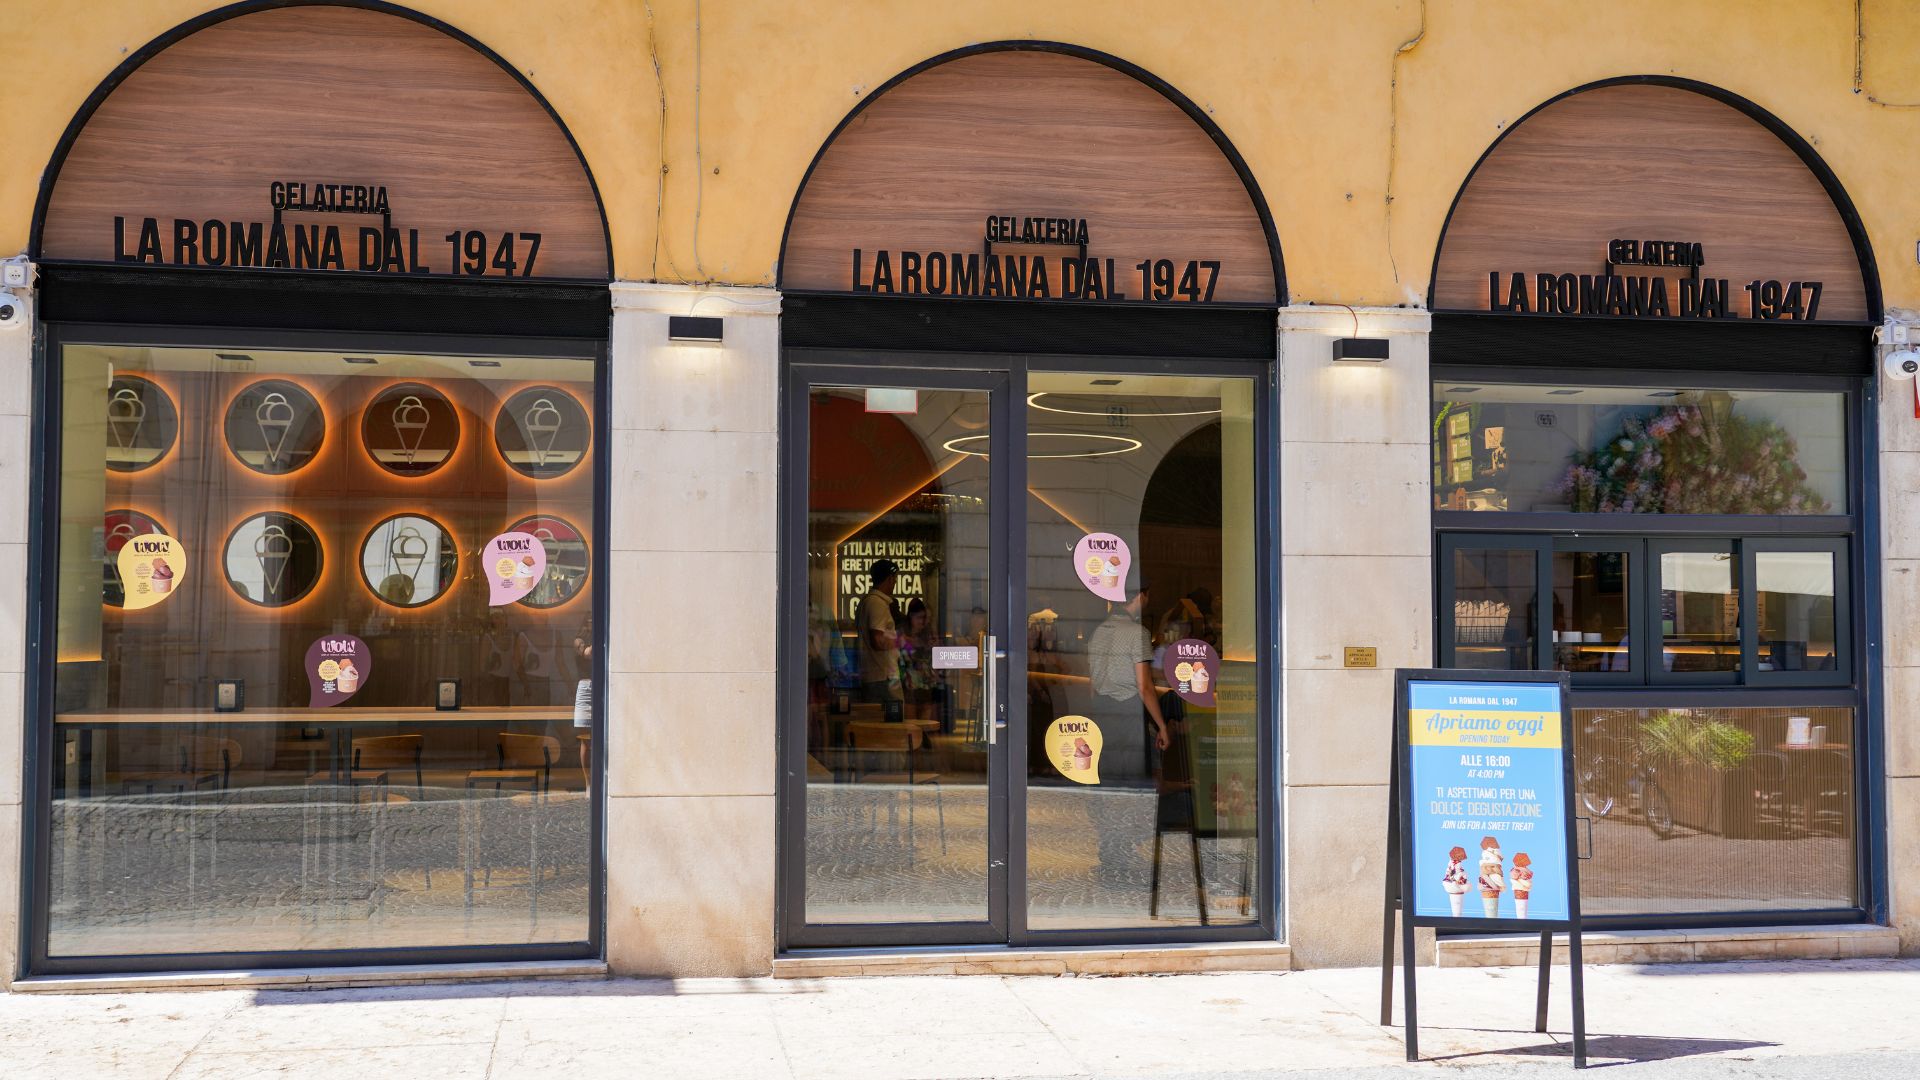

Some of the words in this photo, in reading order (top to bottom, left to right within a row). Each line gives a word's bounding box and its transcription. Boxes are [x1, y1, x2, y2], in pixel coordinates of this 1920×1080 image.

[271, 181, 389, 213] GELATERIA
[986, 215, 1090, 245] GELATERIA
[114, 216, 164, 264] LA
[174, 218, 345, 270] ROMANA
[359, 227, 430, 274] DAL
[445, 230, 542, 277] 1947
[1607, 238, 1705, 267] GELATERIA
[853, 248, 894, 294] LA
[901, 251, 1050, 299] ROMANA
[1061, 257, 1126, 301] DAL
[1136, 259, 1221, 302] 1947
[1488, 271, 1531, 313] LA
[1535, 272, 1670, 317] ROMANA
[1677, 277, 1739, 319] DAL
[1744, 279, 1823, 320] 1947
[842, 558, 862, 572] ERE
[939, 651, 971, 660] SPINGERE
[1449, 696, 1458, 705] LA
[1459, 696, 1486, 705] ROMANA
[1487, 697, 1499, 706] DAL
[1502, 697, 1518, 706] 1947
[1426, 712, 1501, 734] Apriamo
[1506, 715, 1544, 736] oggi
[1459, 734, 1488, 743] OPENING
[1489, 735, 1511, 744] TODAY
[1460, 754, 1482, 767] ALLE
[1485, 755, 1511, 767] 16:00
[1467, 769, 1477, 778] AT
[1477, 769, 1493, 779] 4:00
[1493, 770, 1505, 779] PM
[1436, 787, 1444, 798] TI
[1447, 787, 1498, 799] ASPETTIAMO
[1500, 788, 1516, 800] PER
[1518, 789, 1536, 801] UNA
[1431, 801, 1464, 815] DOLCE
[1468, 801, 1543, 818] DEGUSTAZIONE
[1441, 820, 1457, 829] JOIN
[1457, 821, 1467, 830] US
[1467, 821, 1481, 830] FOR
[1481, 821, 1487, 830] A
[1487, 821, 1511, 831] SWEET
[1511, 822, 1535, 832] TREAT!
